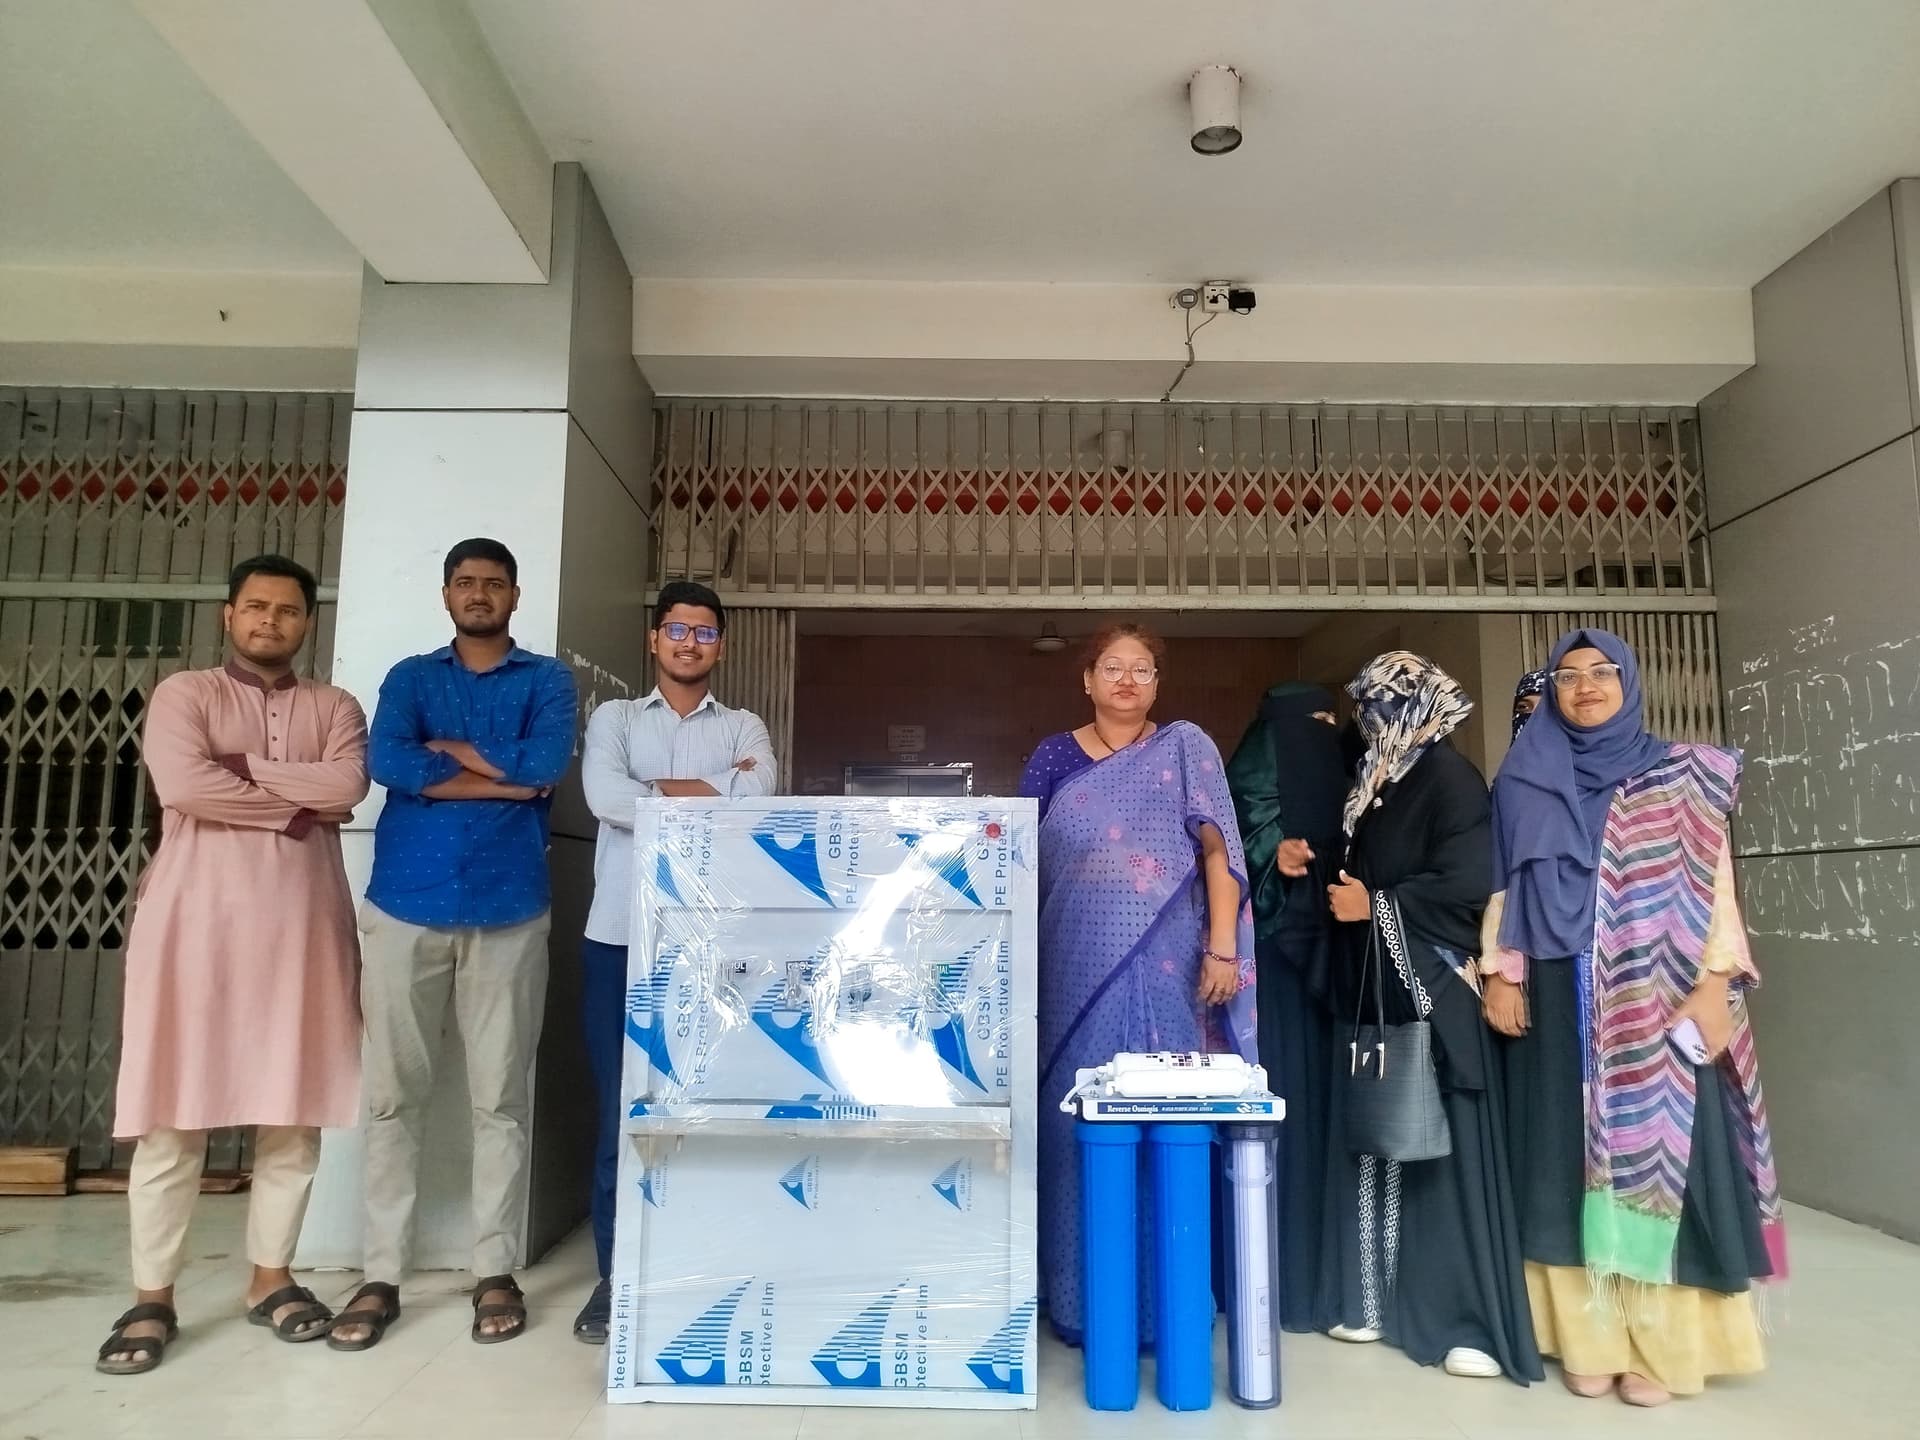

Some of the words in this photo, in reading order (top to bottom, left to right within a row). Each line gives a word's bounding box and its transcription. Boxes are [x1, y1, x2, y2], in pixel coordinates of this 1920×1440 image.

[846, 884, 857, 904] PE
[995, 886, 1006, 905] PE
[998, 940, 1009, 973] Film
[997, 977, 1009, 1059] Proective
[997, 1066, 1008, 1087] PE
[1107, 1104, 1131, 1112] Reverse
[616, 1284, 630, 1319] Film
[762, 1282, 775, 1316] Film
[916, 1285, 928, 1320] Film
[739, 1330, 754, 1384] GBSM
[895, 1333, 909, 1387] GBSM
